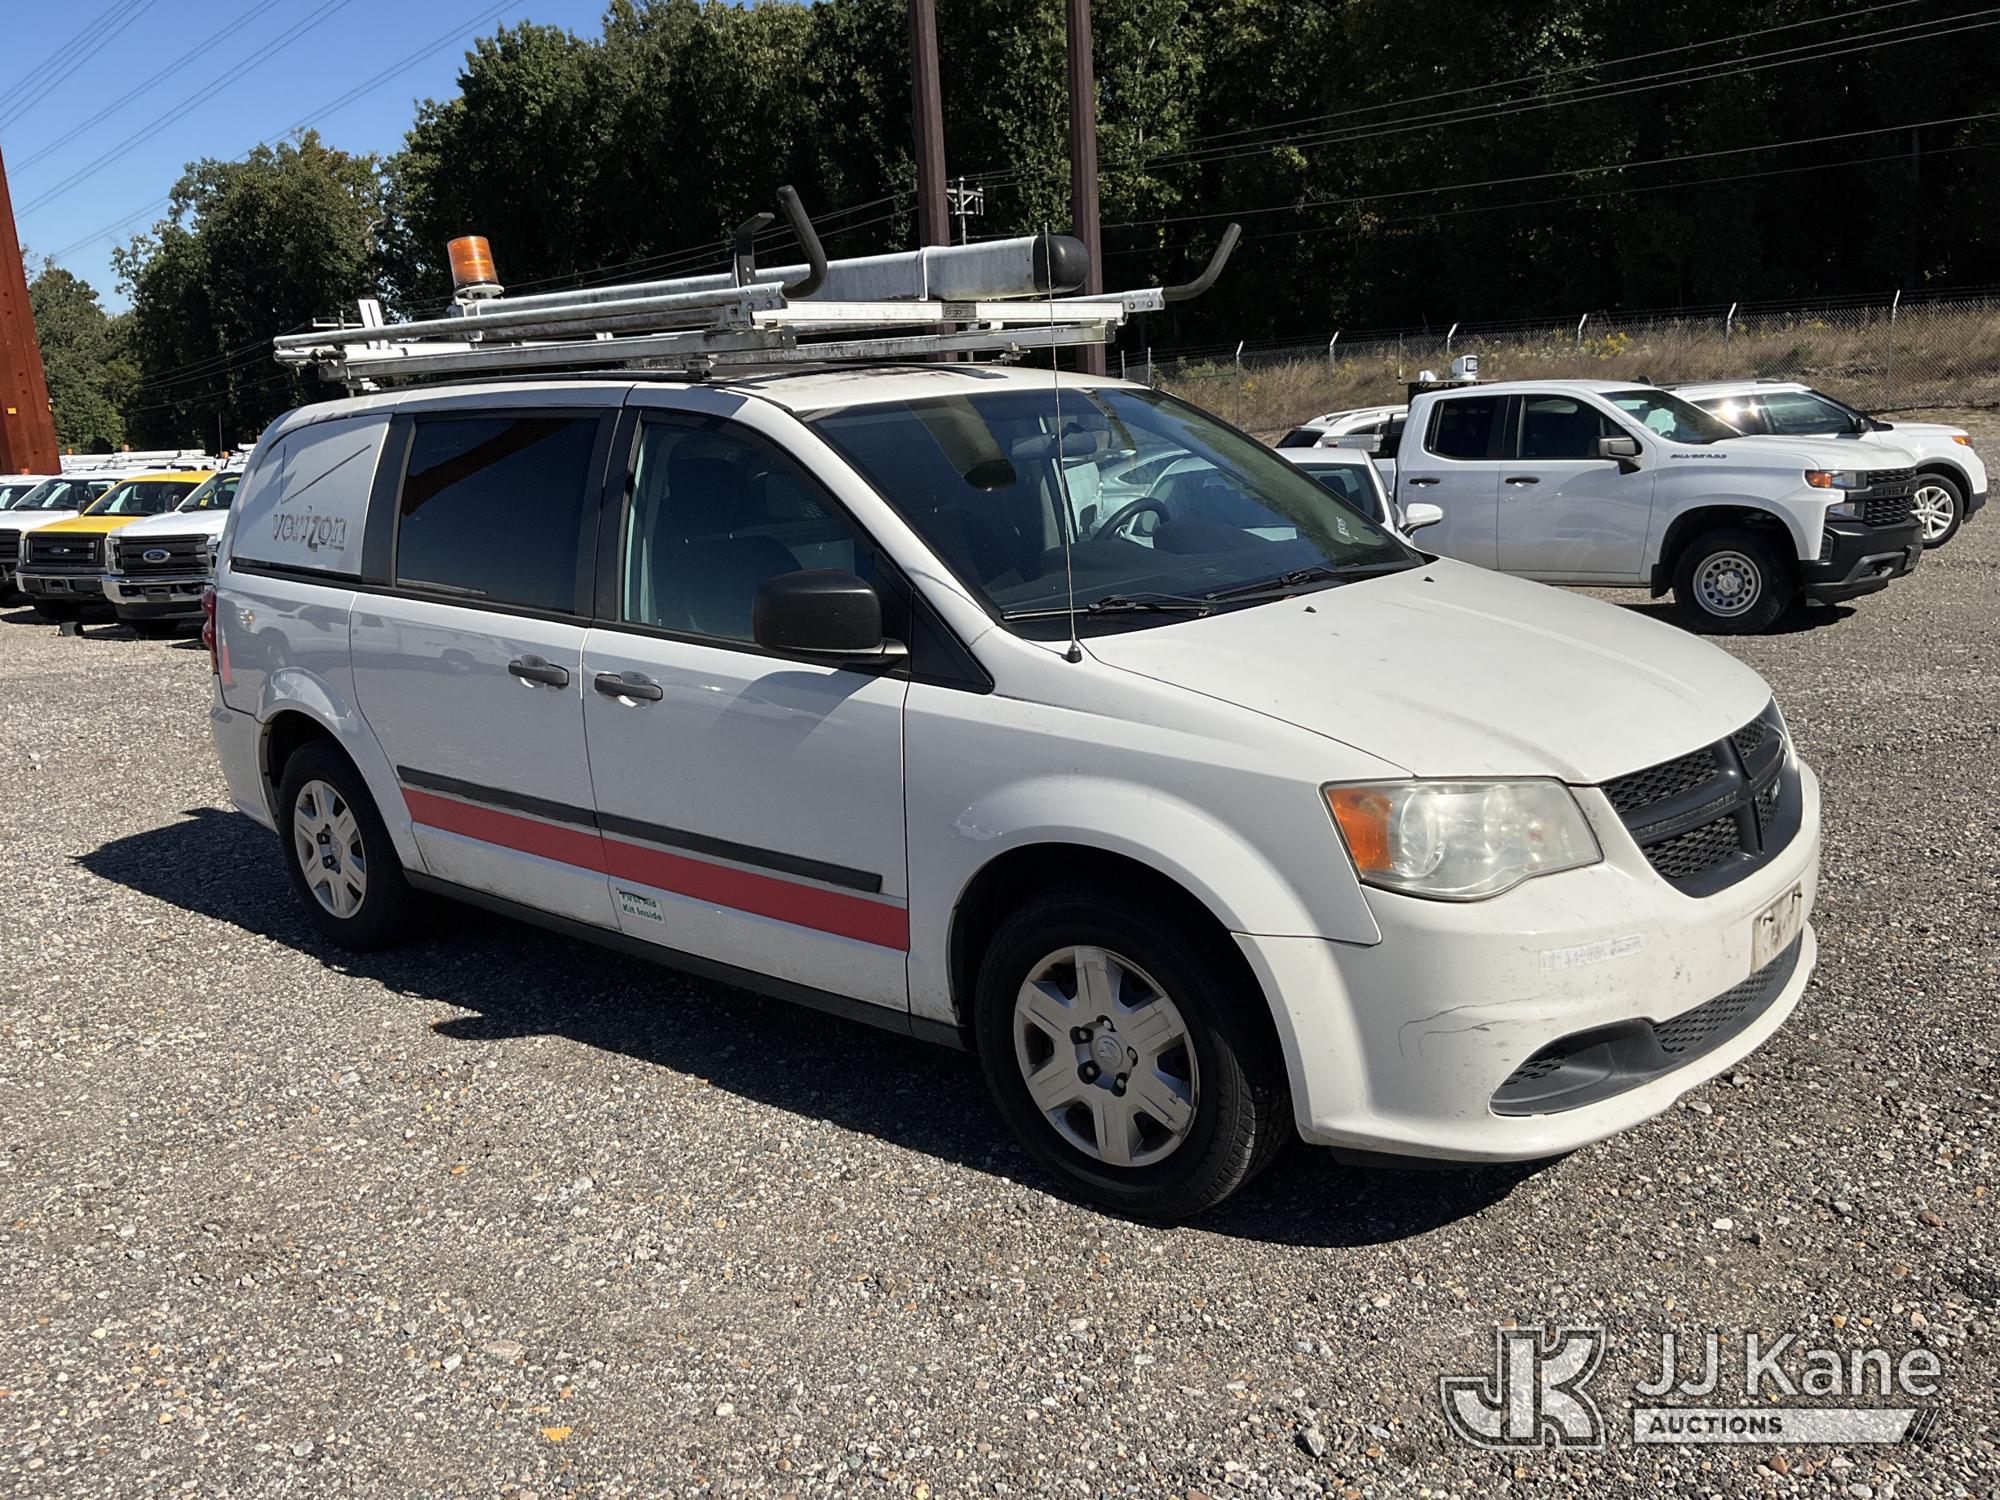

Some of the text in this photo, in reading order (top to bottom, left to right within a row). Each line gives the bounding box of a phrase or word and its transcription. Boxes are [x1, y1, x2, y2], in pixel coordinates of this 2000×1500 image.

[273, 505, 347, 552] verizon
[623, 904, 662, 921] Kit Inside
